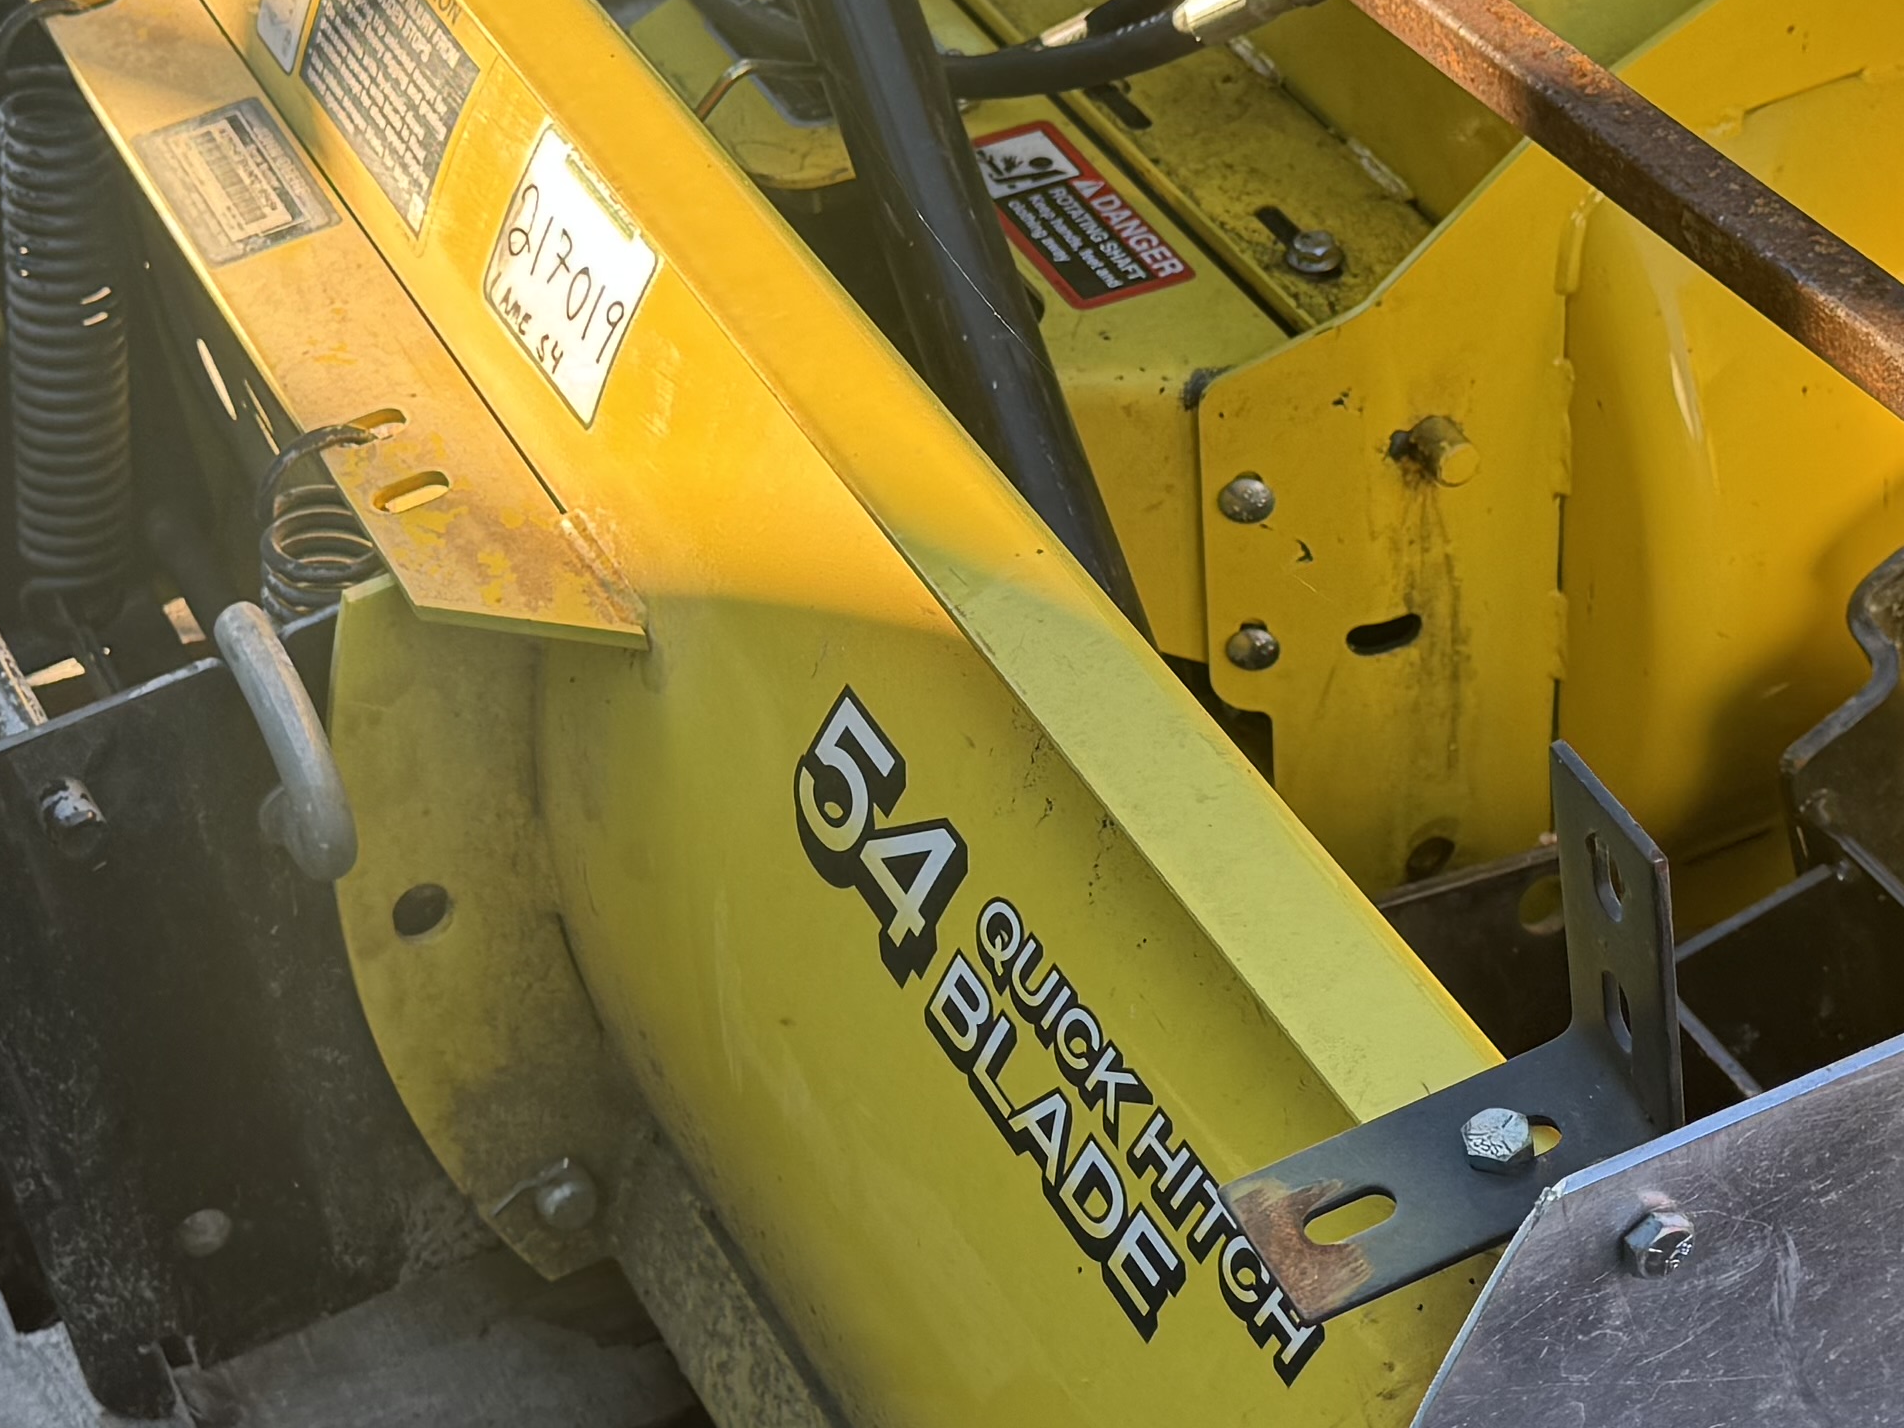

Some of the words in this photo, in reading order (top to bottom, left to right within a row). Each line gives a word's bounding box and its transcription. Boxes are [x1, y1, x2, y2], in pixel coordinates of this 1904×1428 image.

[508, 184, 624, 364] 217019
[1049, 187, 1109, 243] ROTATING
[1099, 241, 1146, 280] SHAFT
[1090, 194, 1185, 278] DANGER
[795, 684, 968, 988] 54
[925, 948, 1187, 1344] BLADE
[977, 897, 1153, 1149] QUICK
[1126, 1106, 1325, 1388] HITCH
